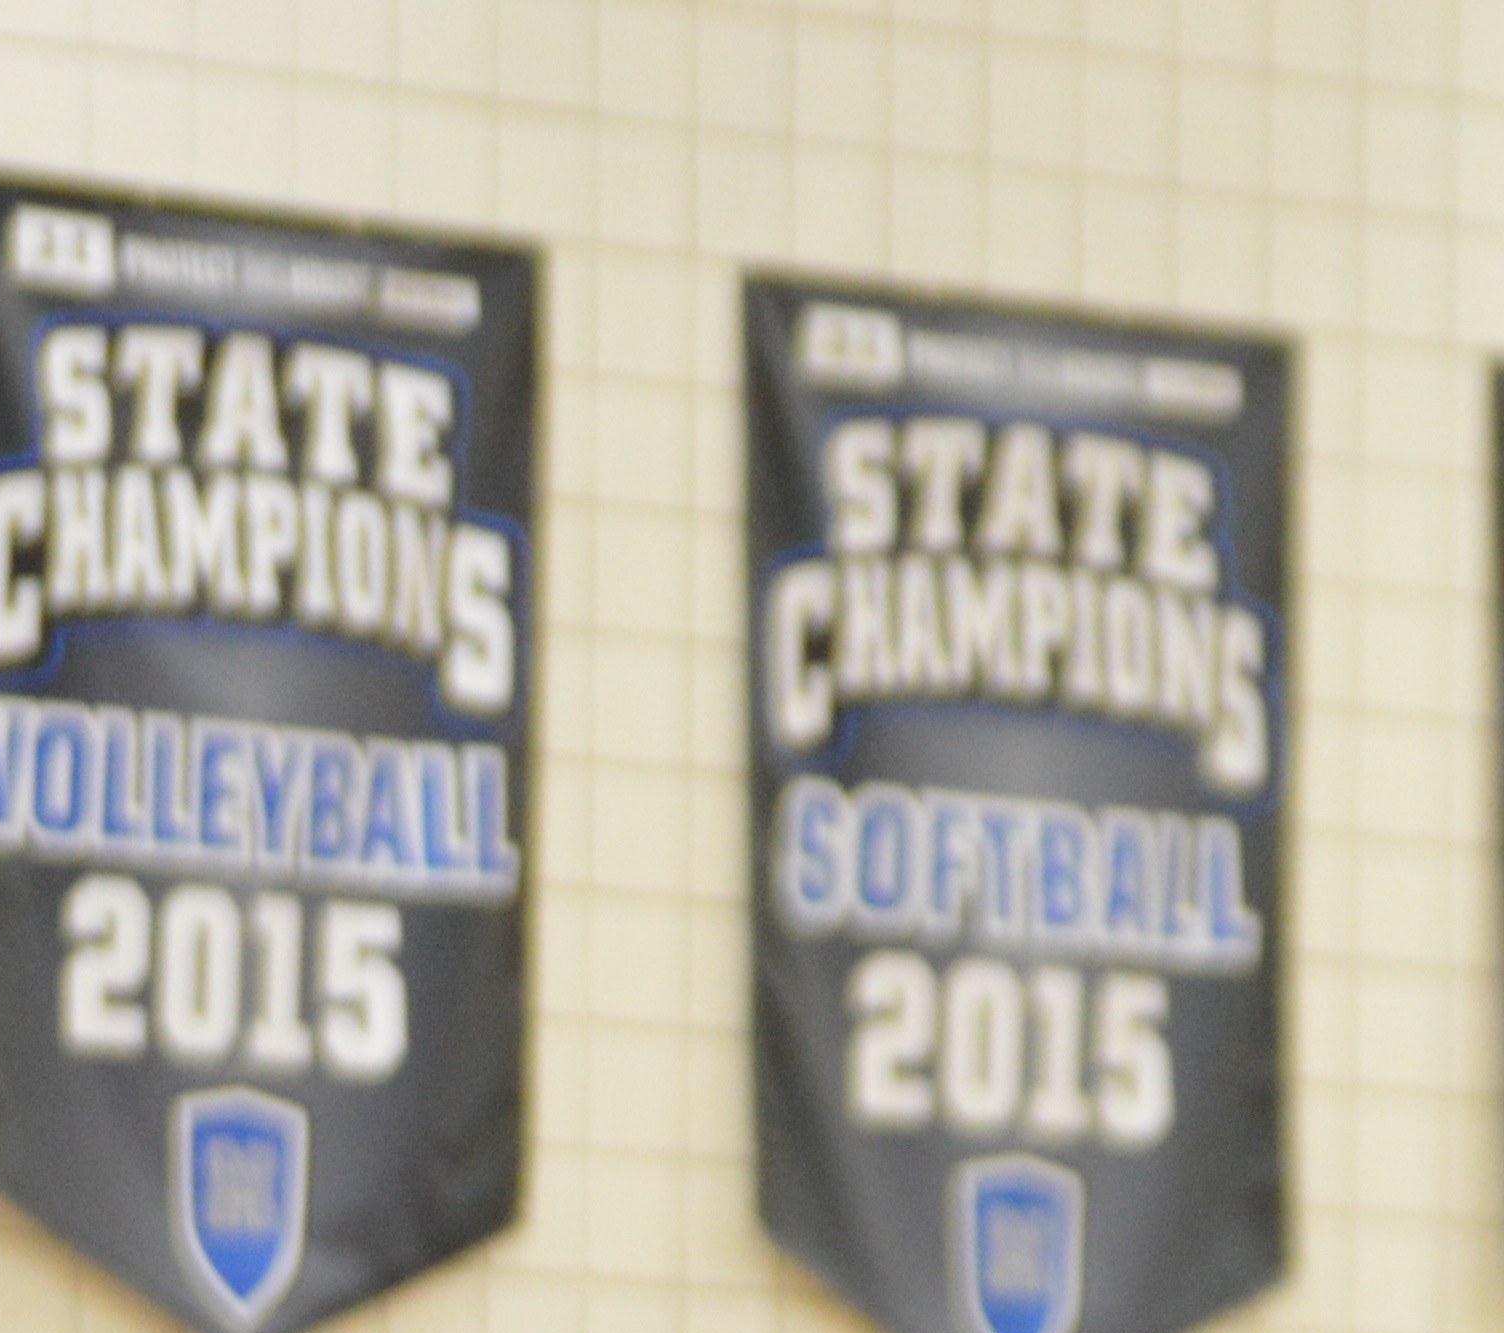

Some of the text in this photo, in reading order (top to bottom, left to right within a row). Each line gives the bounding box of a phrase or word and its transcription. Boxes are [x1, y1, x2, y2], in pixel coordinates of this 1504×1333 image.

[40, 322, 456, 508] STATE
[825, 417, 1218, 595] STATE
[767, 555, 1268, 793] CHAMPIONS
[776, 776, 1263, 975] SOFTBALL
[60, 873, 408, 1084] 2015
[847, 950, 1175, 1152] 2015
